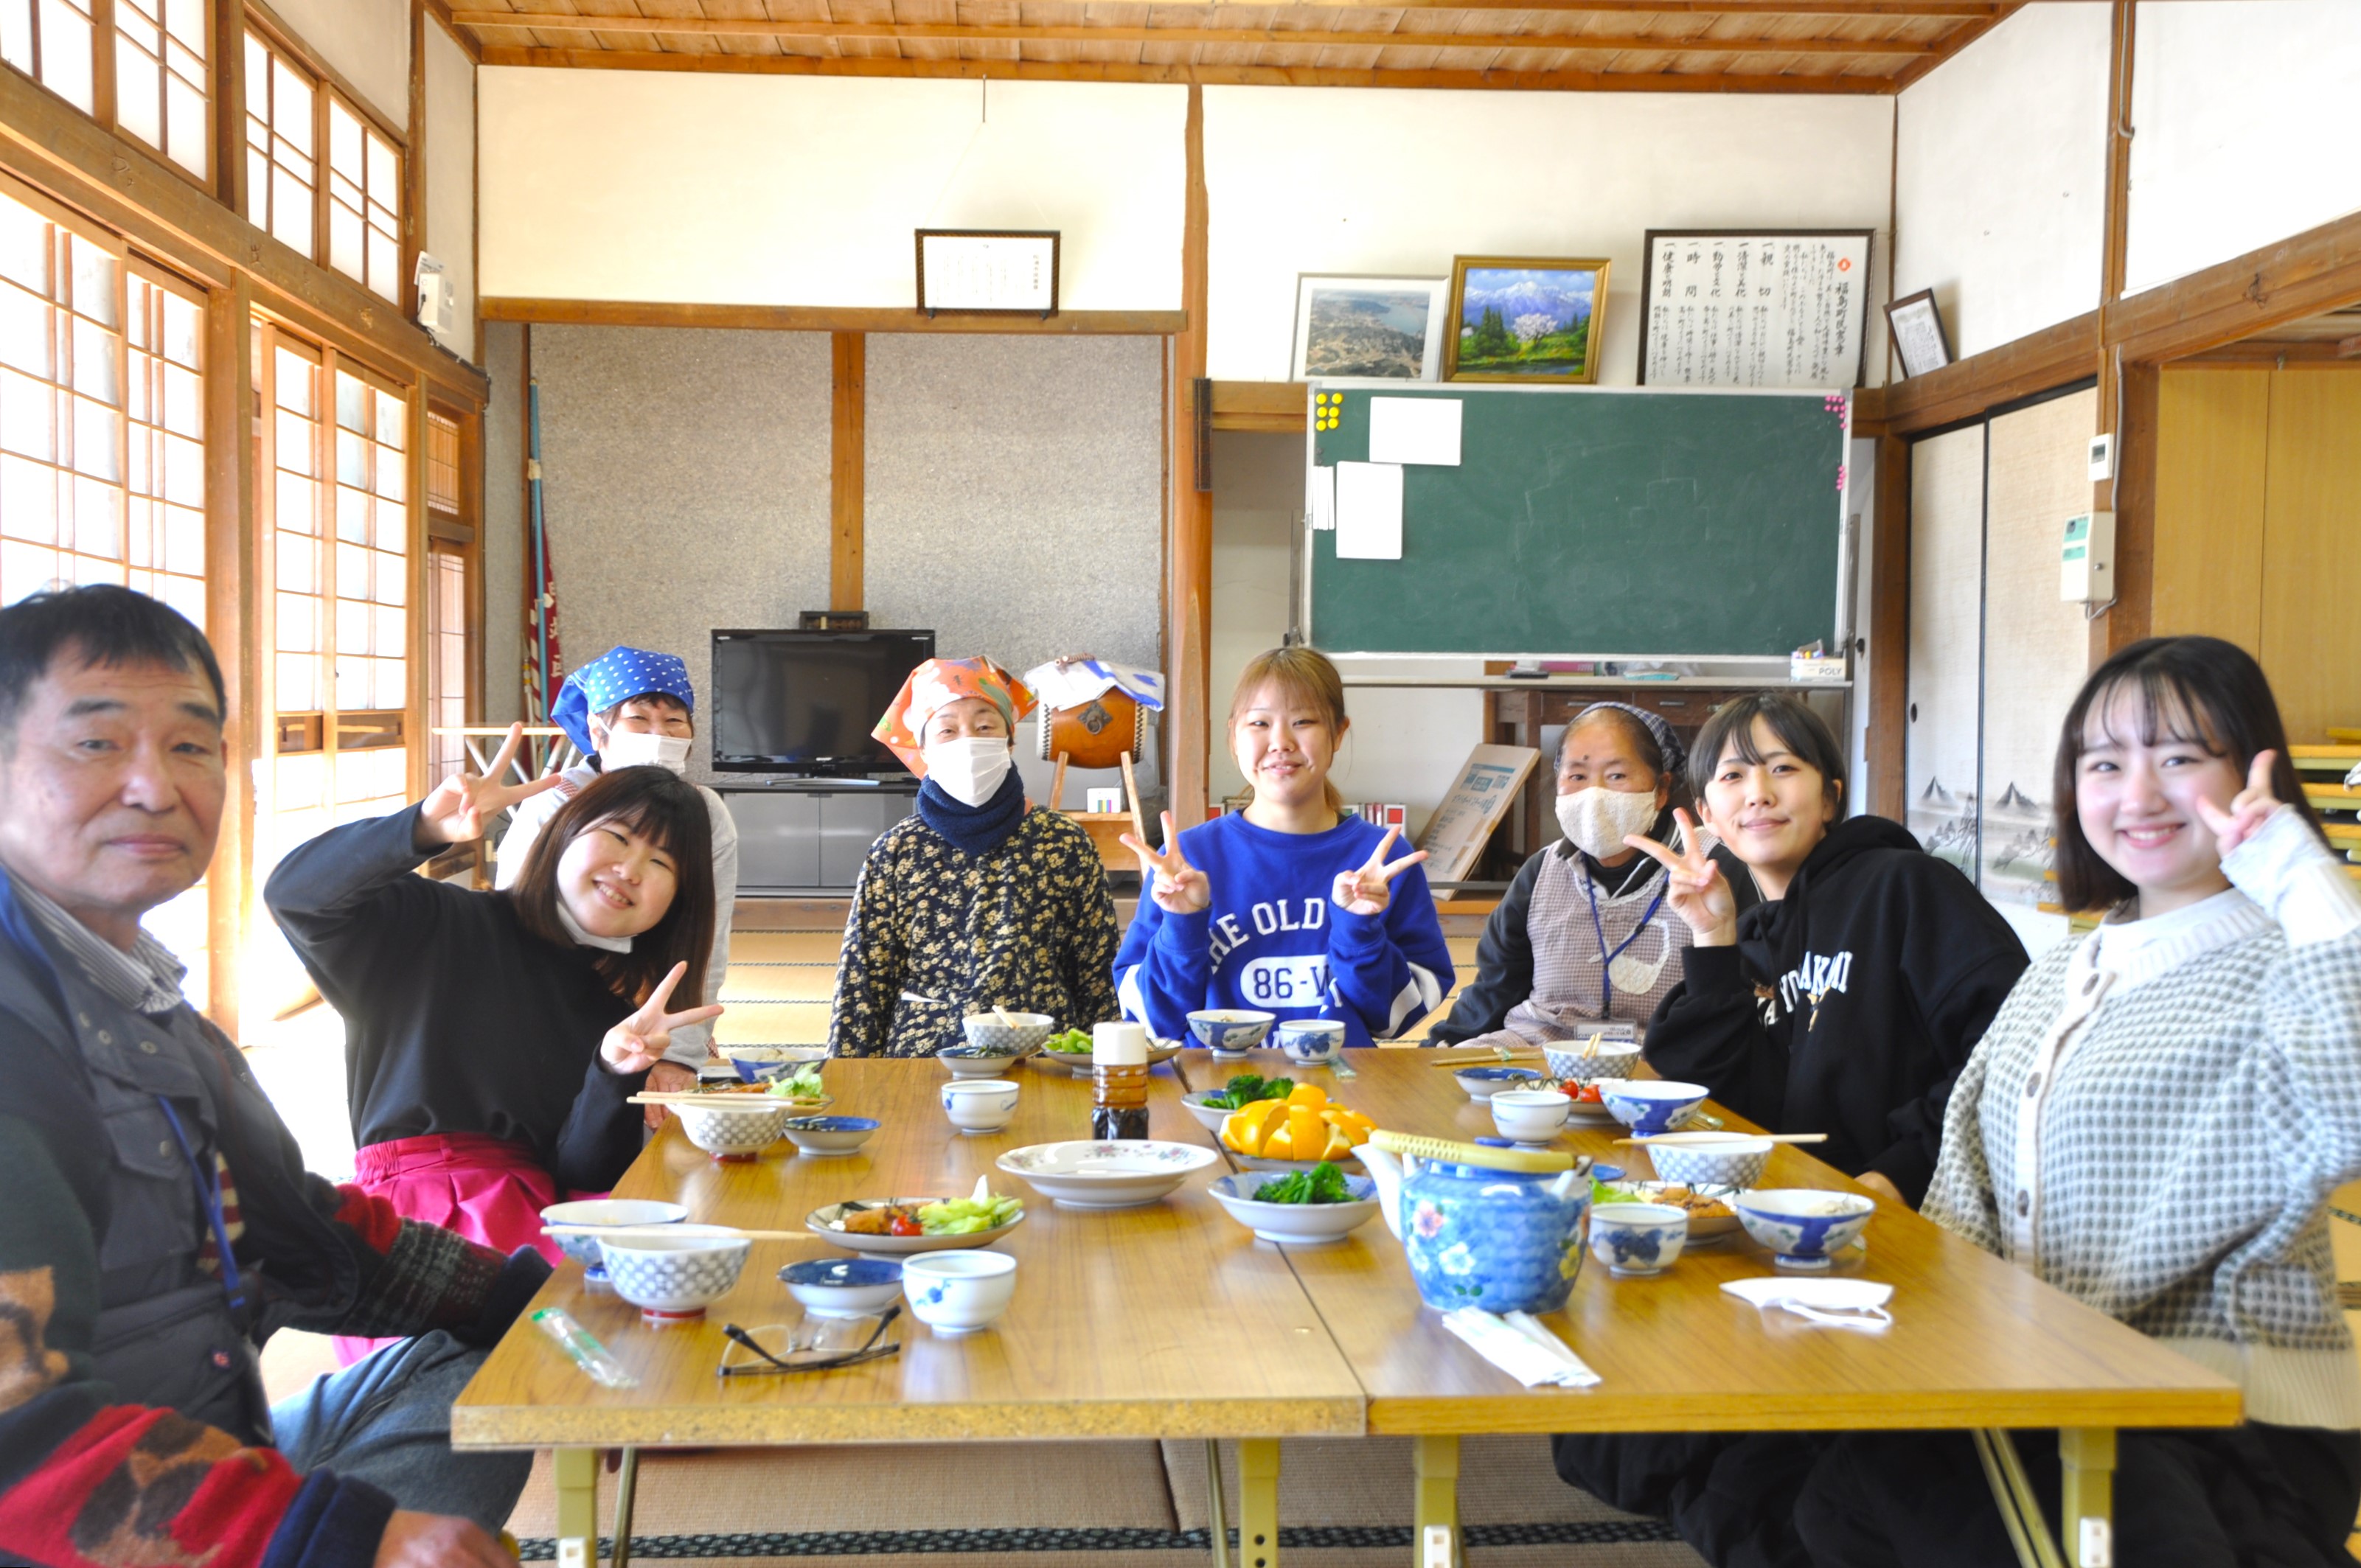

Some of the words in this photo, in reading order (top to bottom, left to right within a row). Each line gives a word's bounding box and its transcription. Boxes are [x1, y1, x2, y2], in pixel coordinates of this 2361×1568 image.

[1818, 667, 1842, 676] POLY
[1209, 913, 1250, 975] HE
[1251, 897, 1326, 935] OLD
